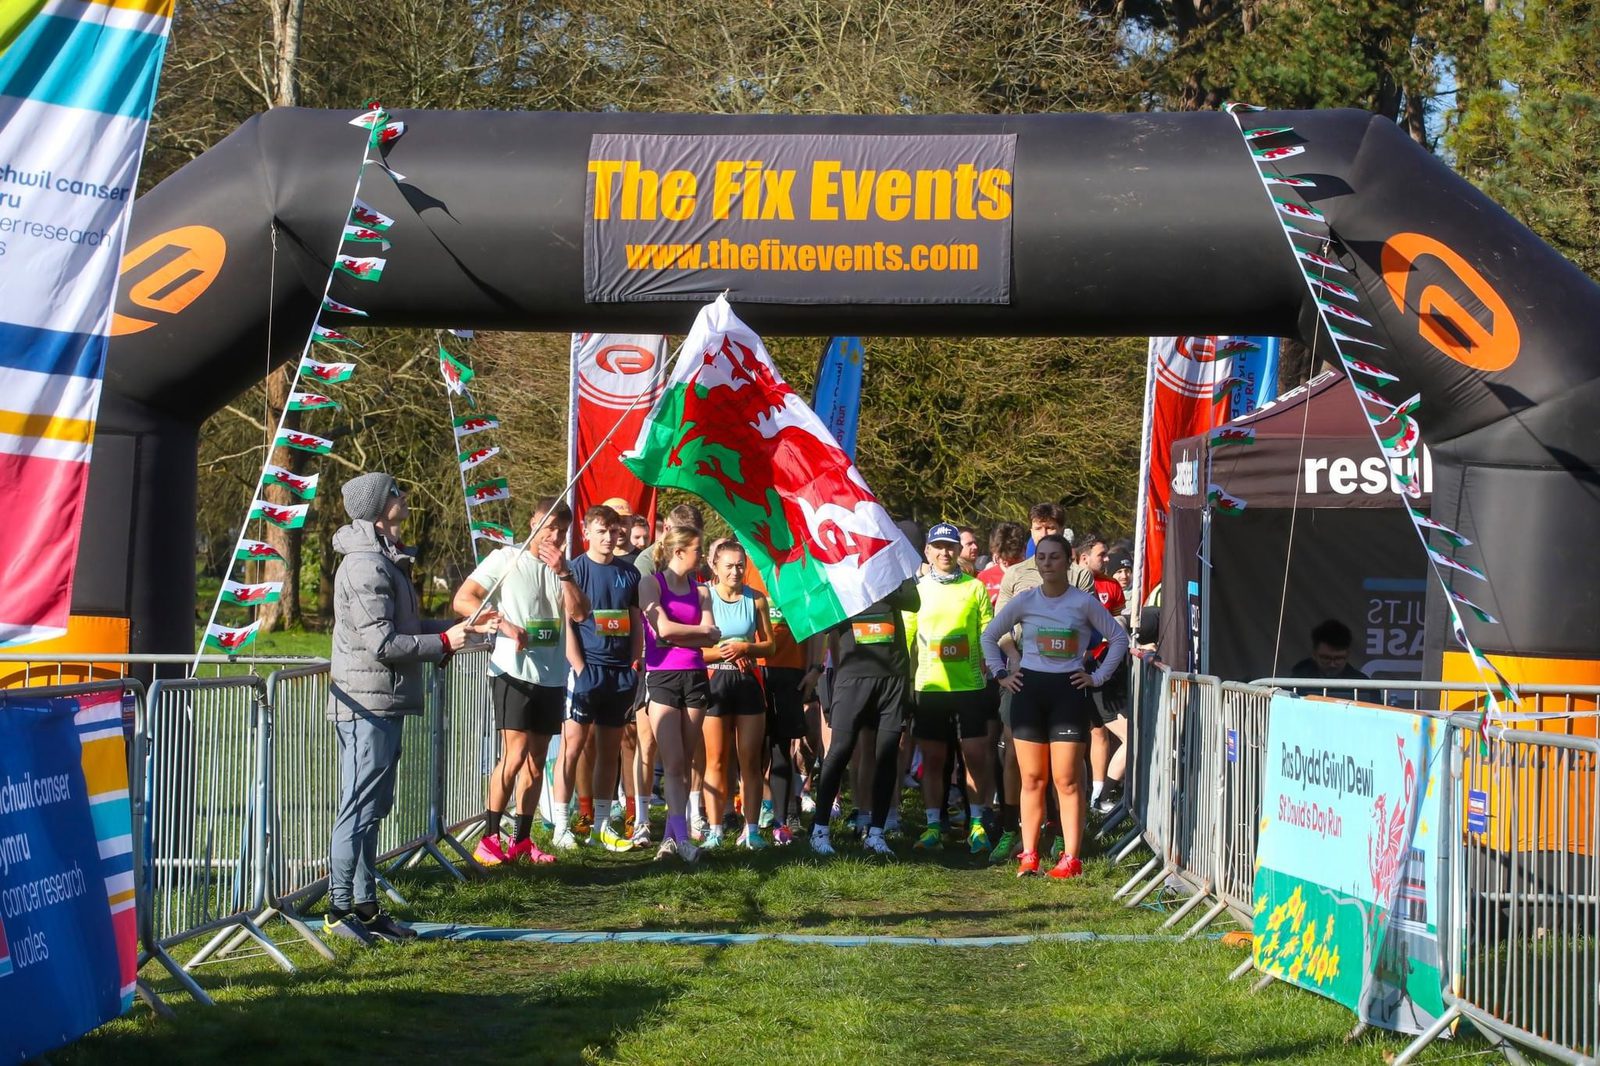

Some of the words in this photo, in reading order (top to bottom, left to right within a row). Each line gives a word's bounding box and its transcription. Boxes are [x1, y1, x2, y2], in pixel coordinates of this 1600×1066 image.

[0, 164, 51, 189] hwil
[55, 178, 129, 201] canser
[588, 160, 697, 221] The
[712, 160, 797, 221] Fix
[810, 160, 1012, 221] Events
[23, 221, 112, 247] research
[625, 238, 978, 271] www.thefixevents.com
[538, 629, 553, 640] 317
[607, 620, 619, 629] 63
[867, 624, 881, 633] 75
[943, 646, 957, 655] 80
[1050, 639, 1066, 650] 151
[1295, 745, 1321, 791] Dydd
[1347, 755, 1373, 798] Dewi
[0, 772, 35, 814] chwil
[34, 773, 71, 807] canser
[1312, 802, 1327, 840] Day
[1328, 807, 1342, 837] Run
[0, 832, 31, 876] ymru
[3, 881, 40, 918] cancer
[39, 860, 86, 905] research
[14, 926, 49, 968] wales
